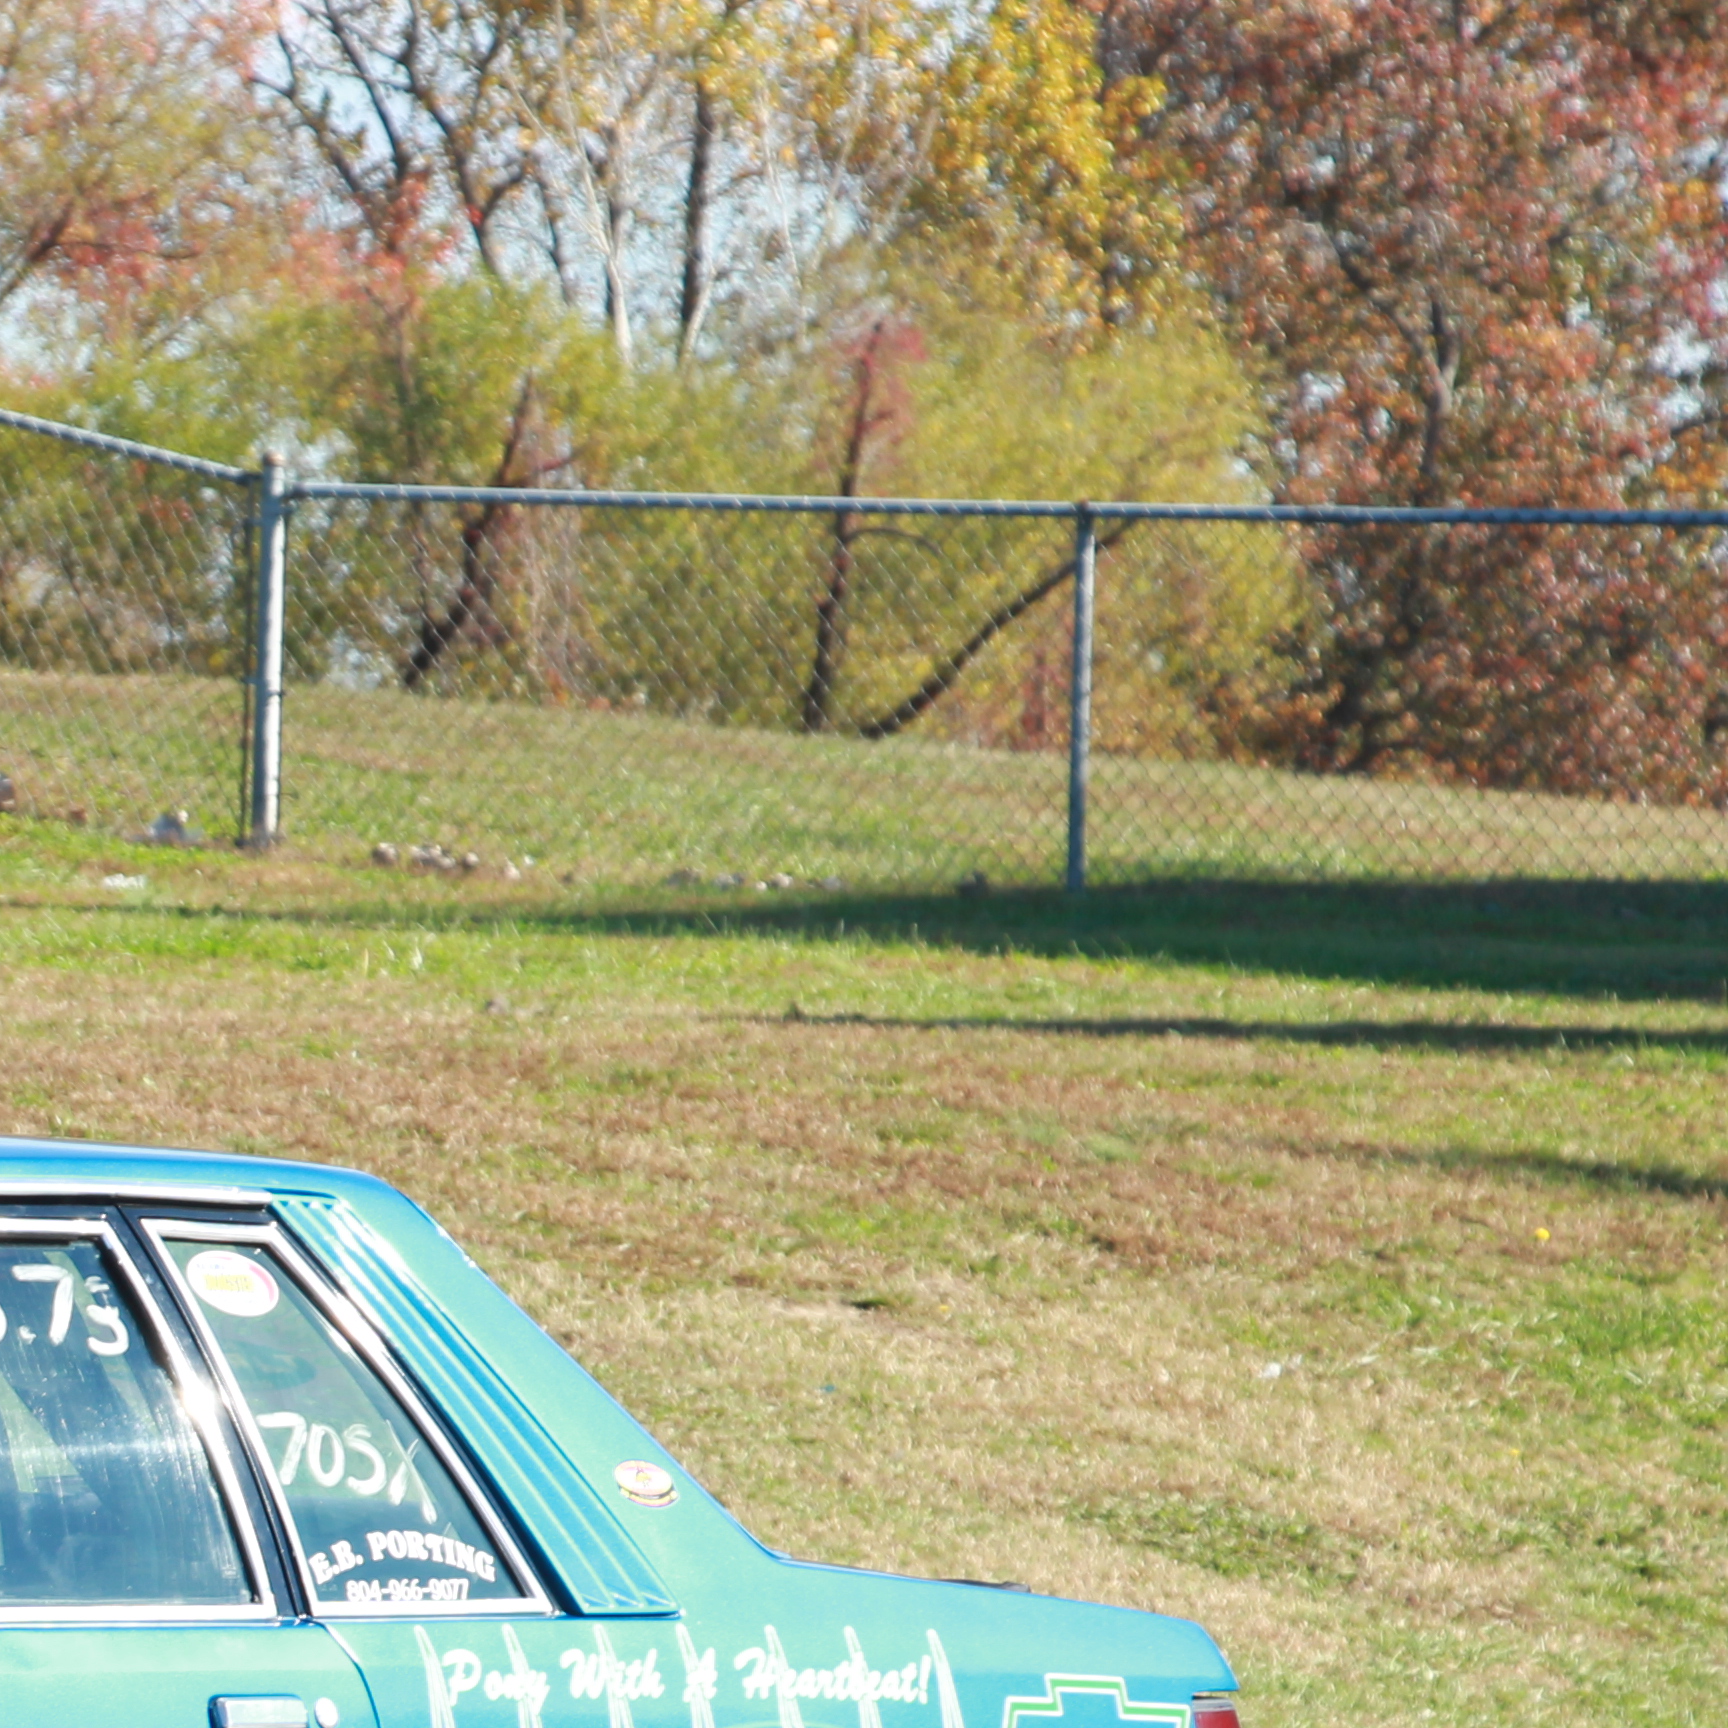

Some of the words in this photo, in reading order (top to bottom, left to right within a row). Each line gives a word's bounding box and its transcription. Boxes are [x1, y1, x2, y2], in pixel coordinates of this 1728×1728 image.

[256, 1411, 438, 1525] 705X
[308, 1534, 365, 1585] E.B.
[366, 1528, 497, 1584] PORTING
[441, 1648, 550, 1714] Pony
[559, 1647, 666, 1700] With
[734, 1646, 933, 1705] Heartbeat!
